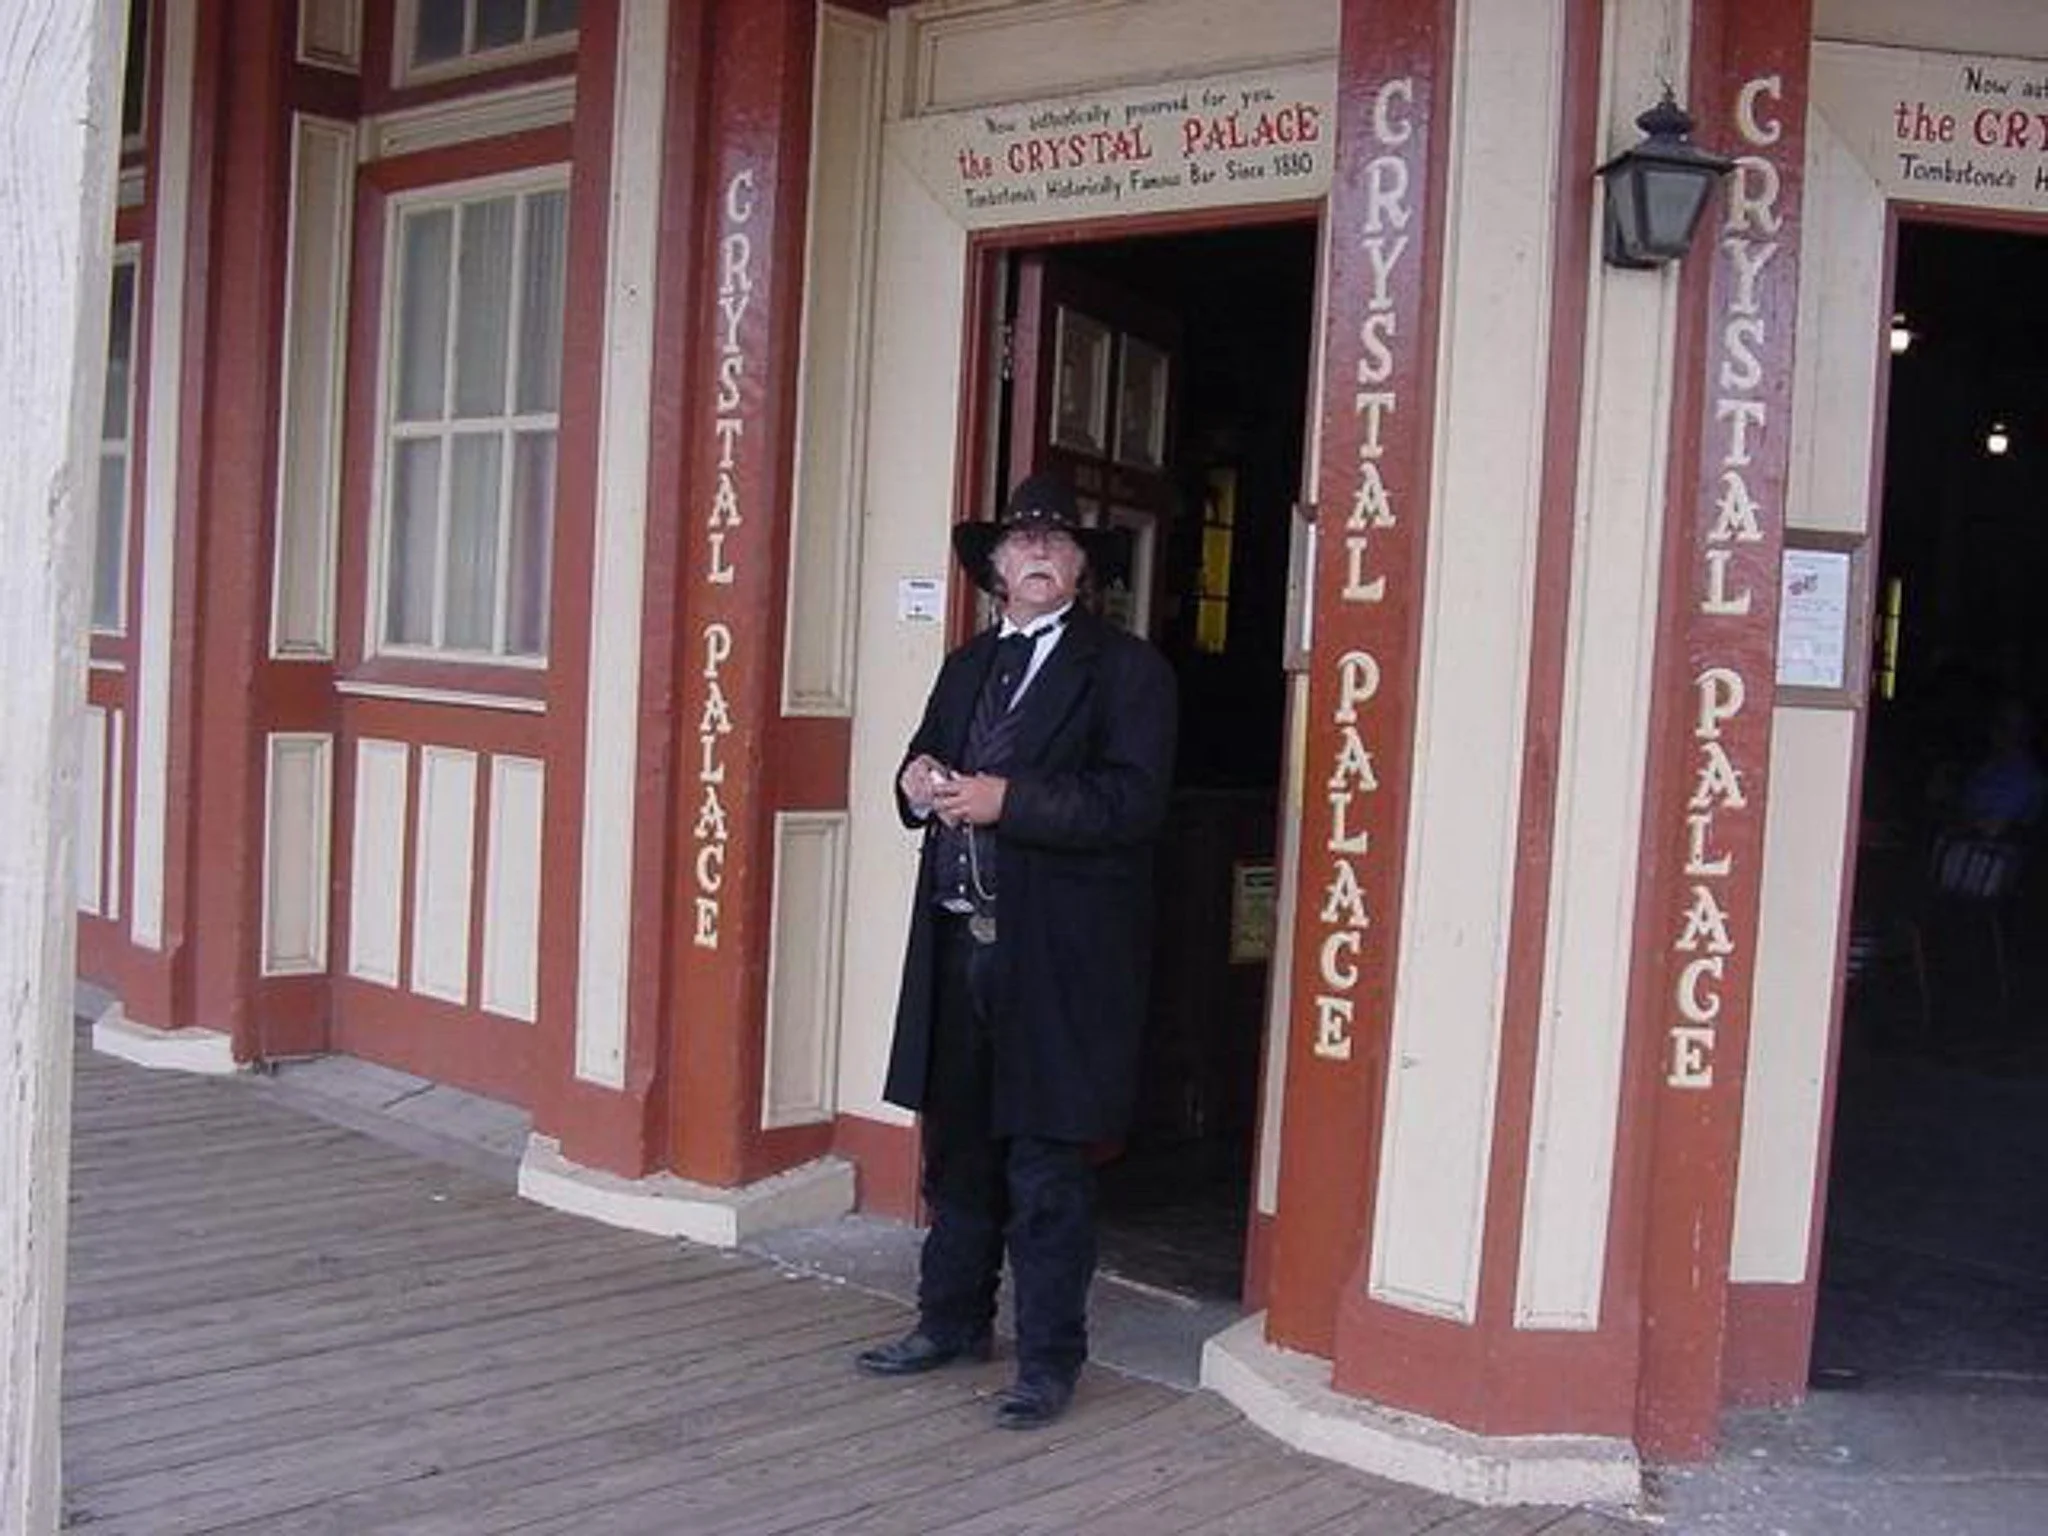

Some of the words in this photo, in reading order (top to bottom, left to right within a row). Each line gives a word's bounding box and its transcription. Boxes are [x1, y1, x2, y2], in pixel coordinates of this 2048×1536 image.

[958, 148, 993, 180] the
[1007, 123, 1153, 174] CRYSTAL
[1182, 102, 1320, 159] PALACE
[1045, 174, 1122, 201] Historically
[1129, 168, 1181, 192] Famous
[1189, 162, 1217, 186] Bar
[1225, 159, 1266, 181] Since
[1272, 150, 1314, 178] 1880
[1202, 88, 1228, 109] for
[1893, 100, 1957, 143] the
[1966, 66, 2011, 96] Now
[707, 169, 753, 584] CRYSTAL
[1342, 76, 1413, 602] CRYSTAL
[1701, 75, 1783, 617] CRYSTAL
[694, 622, 733, 950] PALACE
[1314, 650, 1381, 1062] PALACE
[1666, 667, 1748, 1090] PALACE
